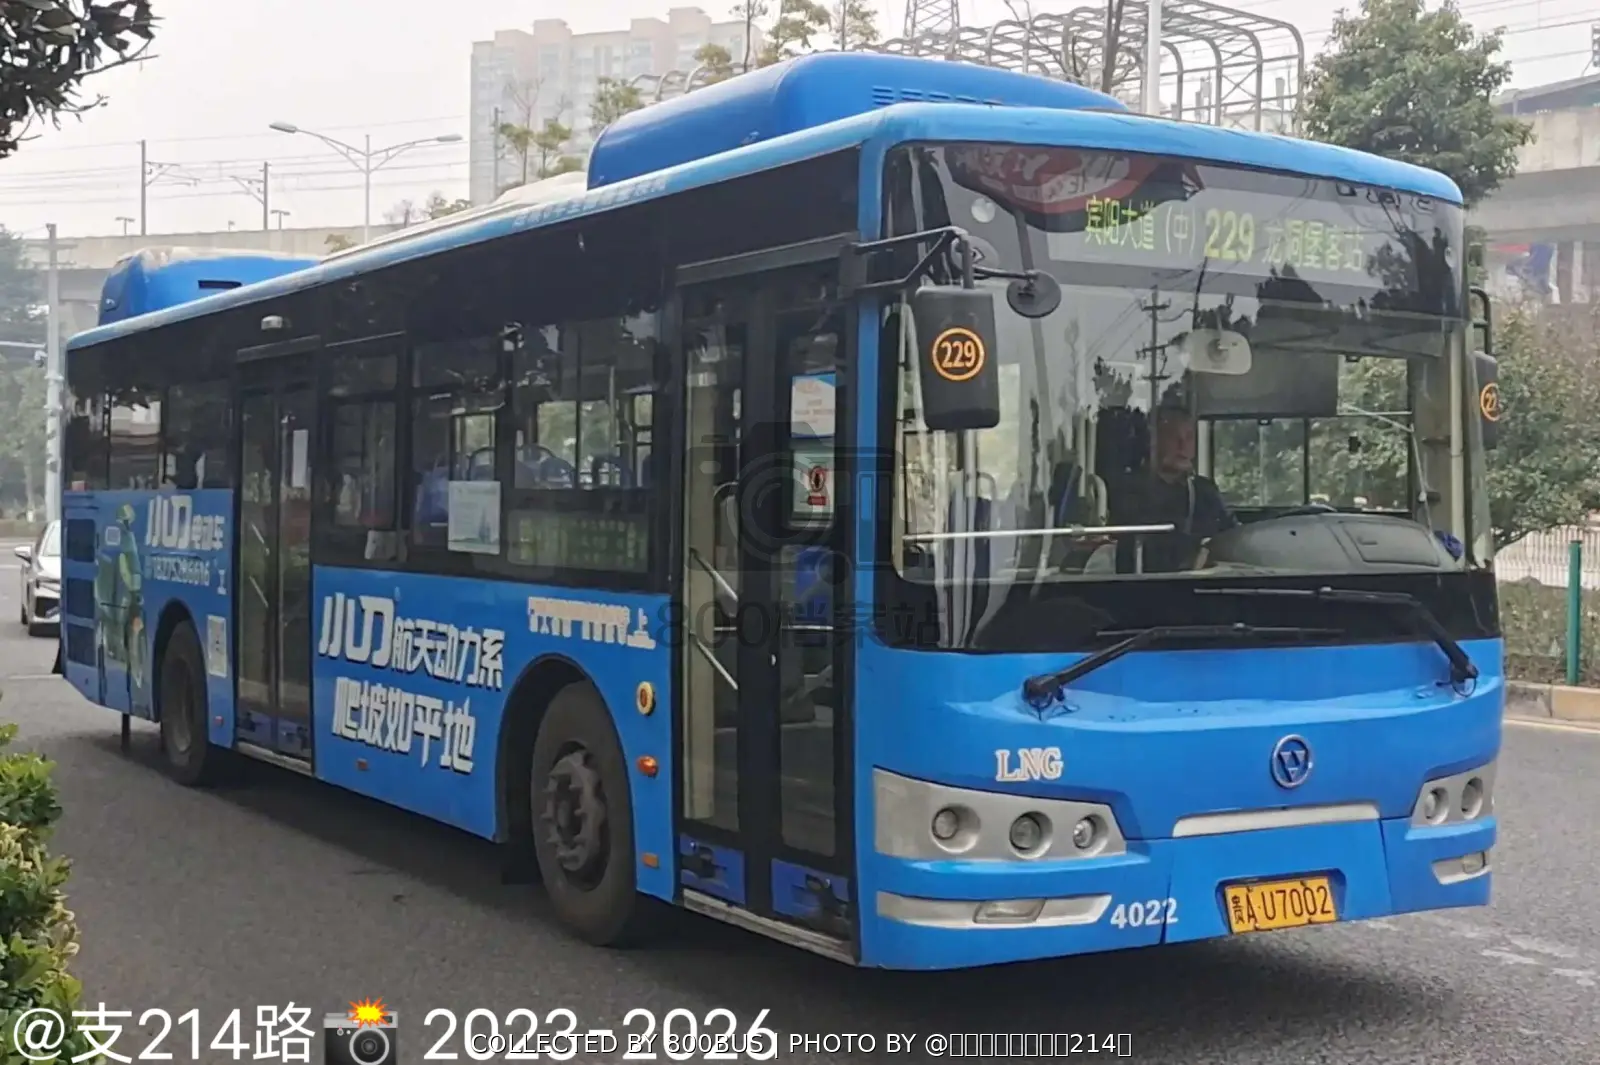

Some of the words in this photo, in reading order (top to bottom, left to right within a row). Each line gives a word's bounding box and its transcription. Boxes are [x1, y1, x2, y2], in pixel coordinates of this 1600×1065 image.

[1204, 208, 1255, 261] 229
[940, 340, 976, 368] 229
[331, 676, 477, 774] 爬坡如平地
[995, 747, 1064, 782] LNG
[1110, 897, 1179, 929] 4022
